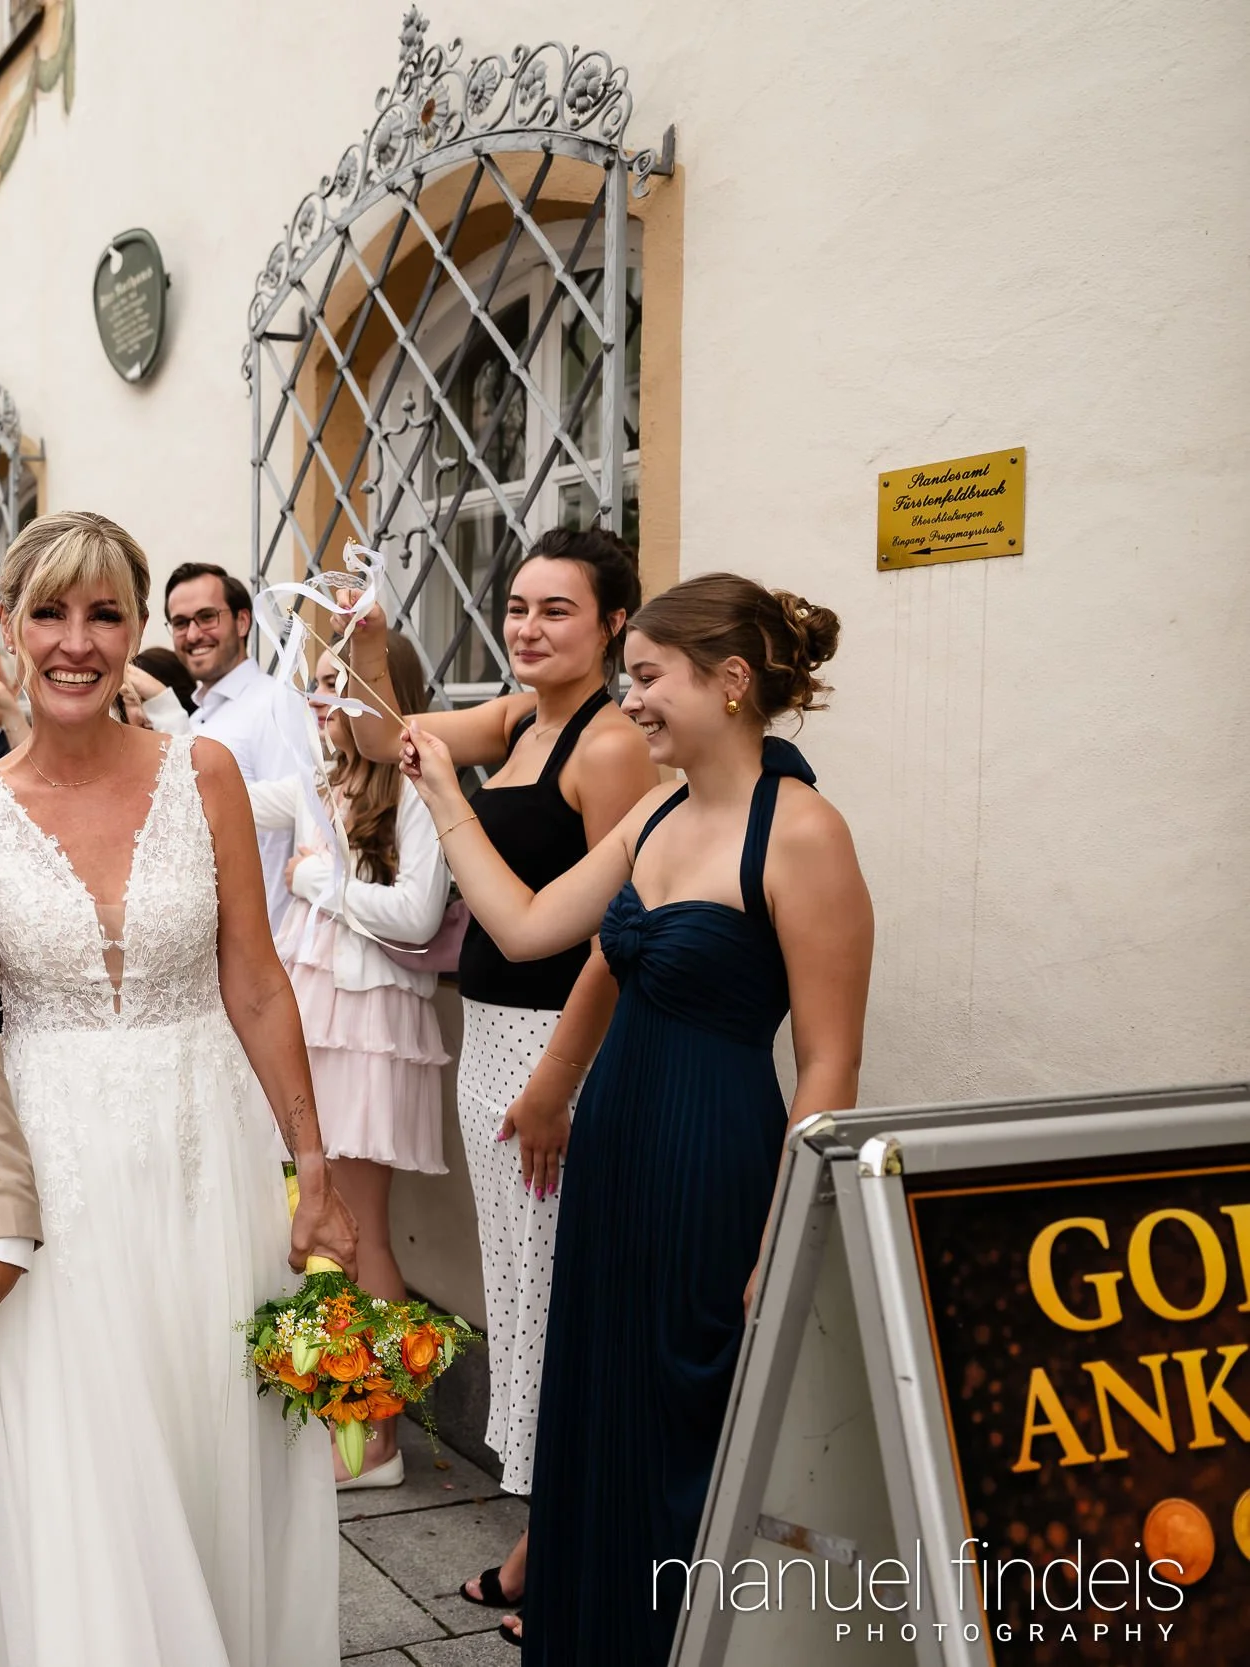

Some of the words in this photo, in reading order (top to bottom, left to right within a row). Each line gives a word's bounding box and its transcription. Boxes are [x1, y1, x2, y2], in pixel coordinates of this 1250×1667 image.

[907, 463, 990, 489] Standesamt
[892, 479, 1007, 512] Fürstenfeldbruck
[891, 535, 926, 548] Eingang
